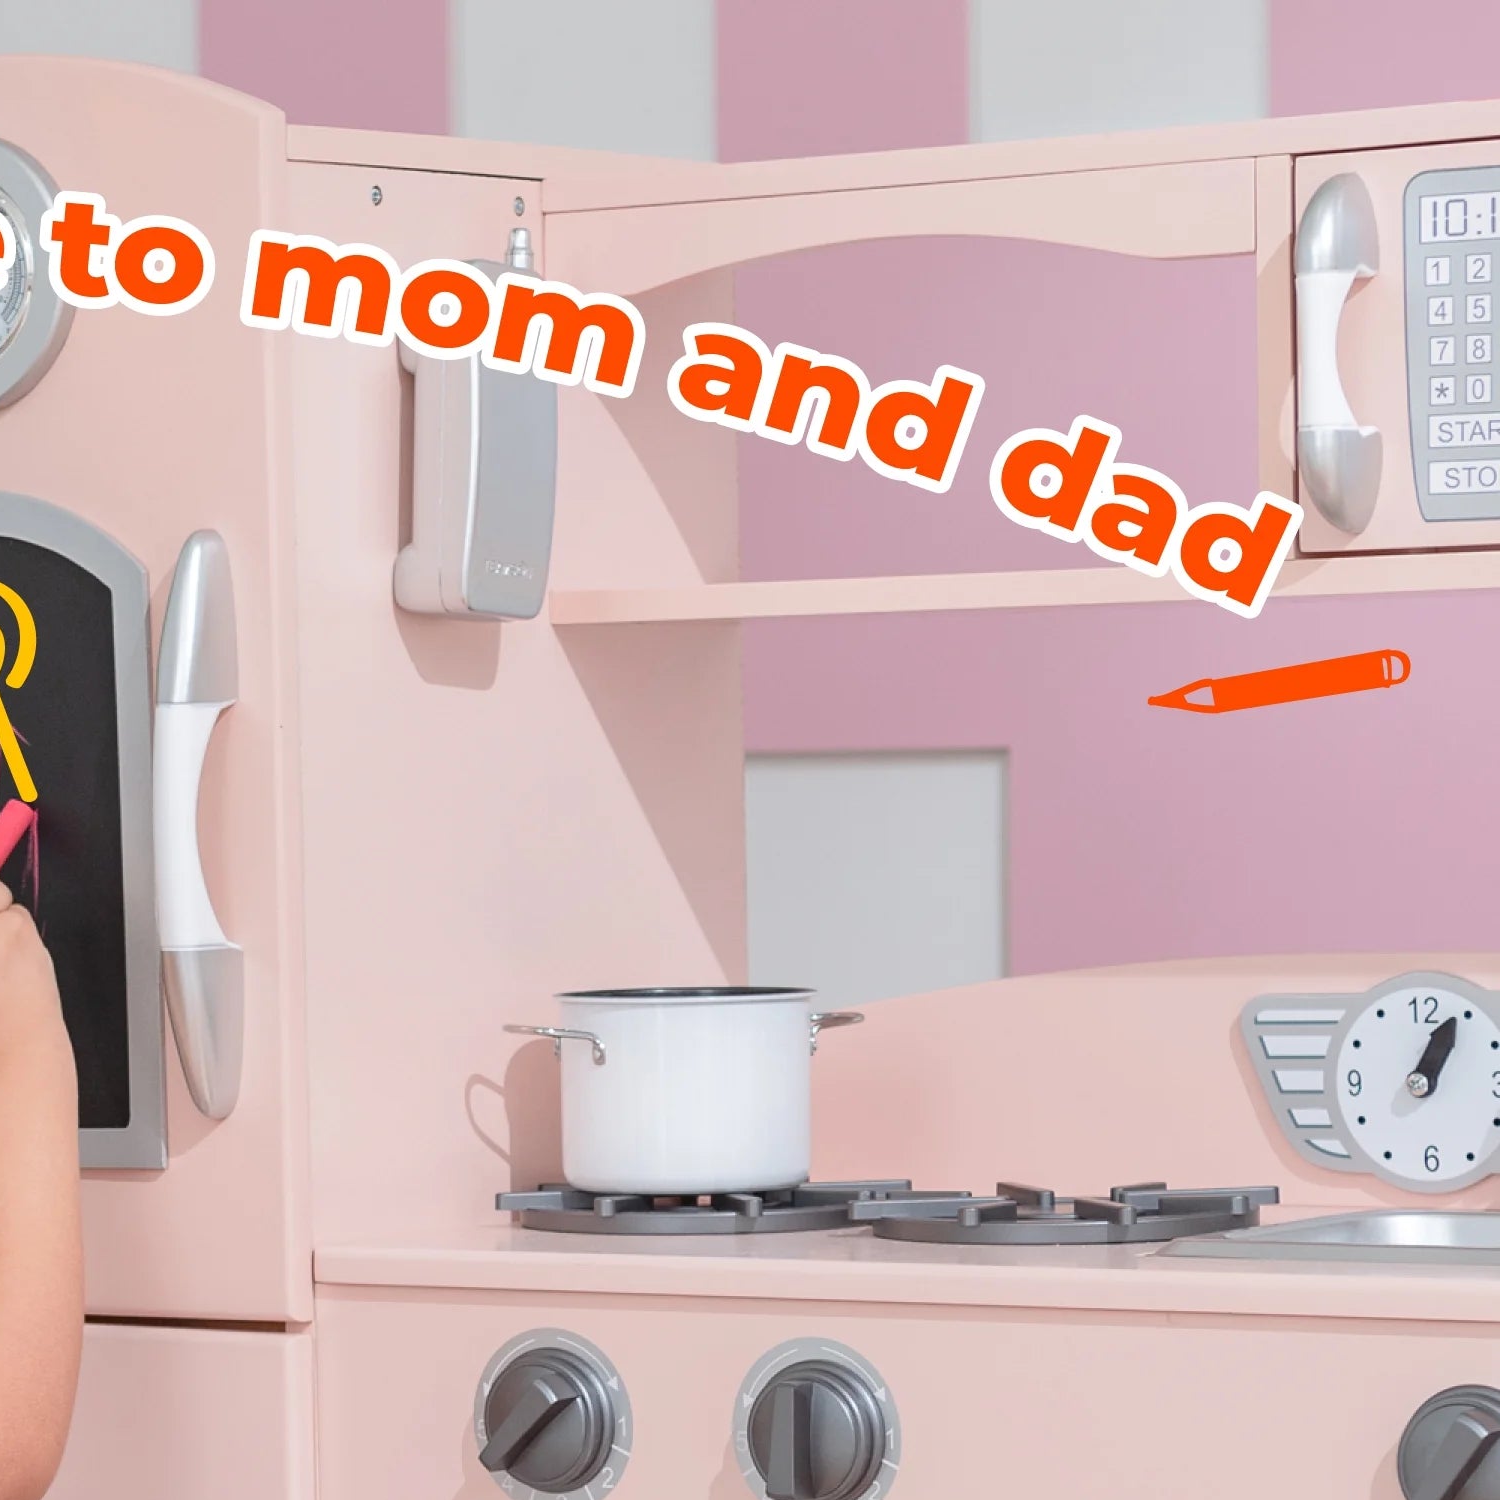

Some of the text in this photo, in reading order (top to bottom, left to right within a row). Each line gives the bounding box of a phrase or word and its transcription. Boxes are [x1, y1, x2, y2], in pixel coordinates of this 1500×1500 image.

[1431, 257, 1486, 282] 1 2
[1434, 297, 1486, 321] 4 5
[1435, 338, 1486, 361] 7 8
[1471, 378, 1485, 400] 0
[1408, 997, 1439, 1024] 12
[1347, 1069, 1362, 1096] 9
[1424, 1145, 1440, 1172] 6
[617, 1415, 628, 1437] 1
[884, 1427, 896, 1450] 1
[601, 1466, 615, 1489] 2
